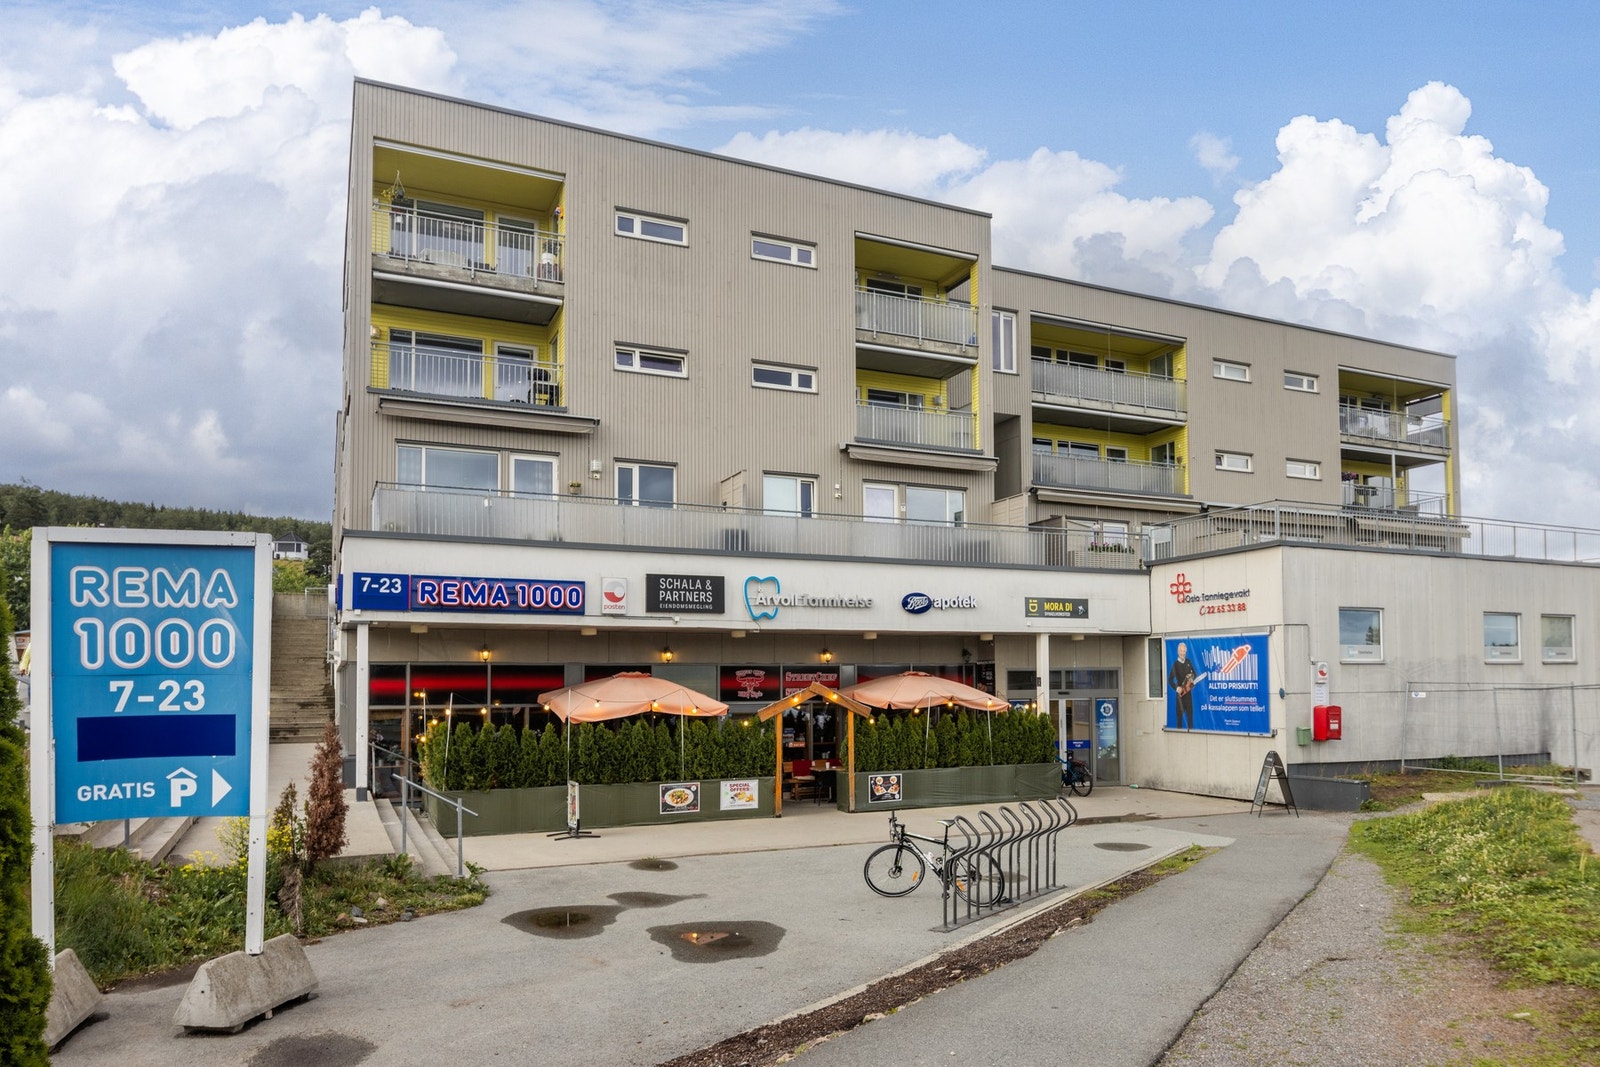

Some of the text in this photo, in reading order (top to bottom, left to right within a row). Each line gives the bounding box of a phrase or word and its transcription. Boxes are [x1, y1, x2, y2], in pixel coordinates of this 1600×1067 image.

[69, 565, 239, 609] REMA
[360, 577, 402, 594] 7-23
[659, 578, 713, 591] SCHALA &
[417, 579, 583, 609] REMA 1000
[659, 590, 713, 603] PARTNERS
[1201, 588, 1250, 601] Tannlegevakt
[604, 603, 626, 611] posten
[933, 595, 978, 610] apotek
[1044, 602, 1064, 611] MORA
[1207, 605, 1215, 614] 22
[73, 617, 236, 670] 1000
[1208, 682, 1228, 690] ALLTID
[109, 680, 206, 713] 7-23
[77, 782, 156, 802] GRATIS
